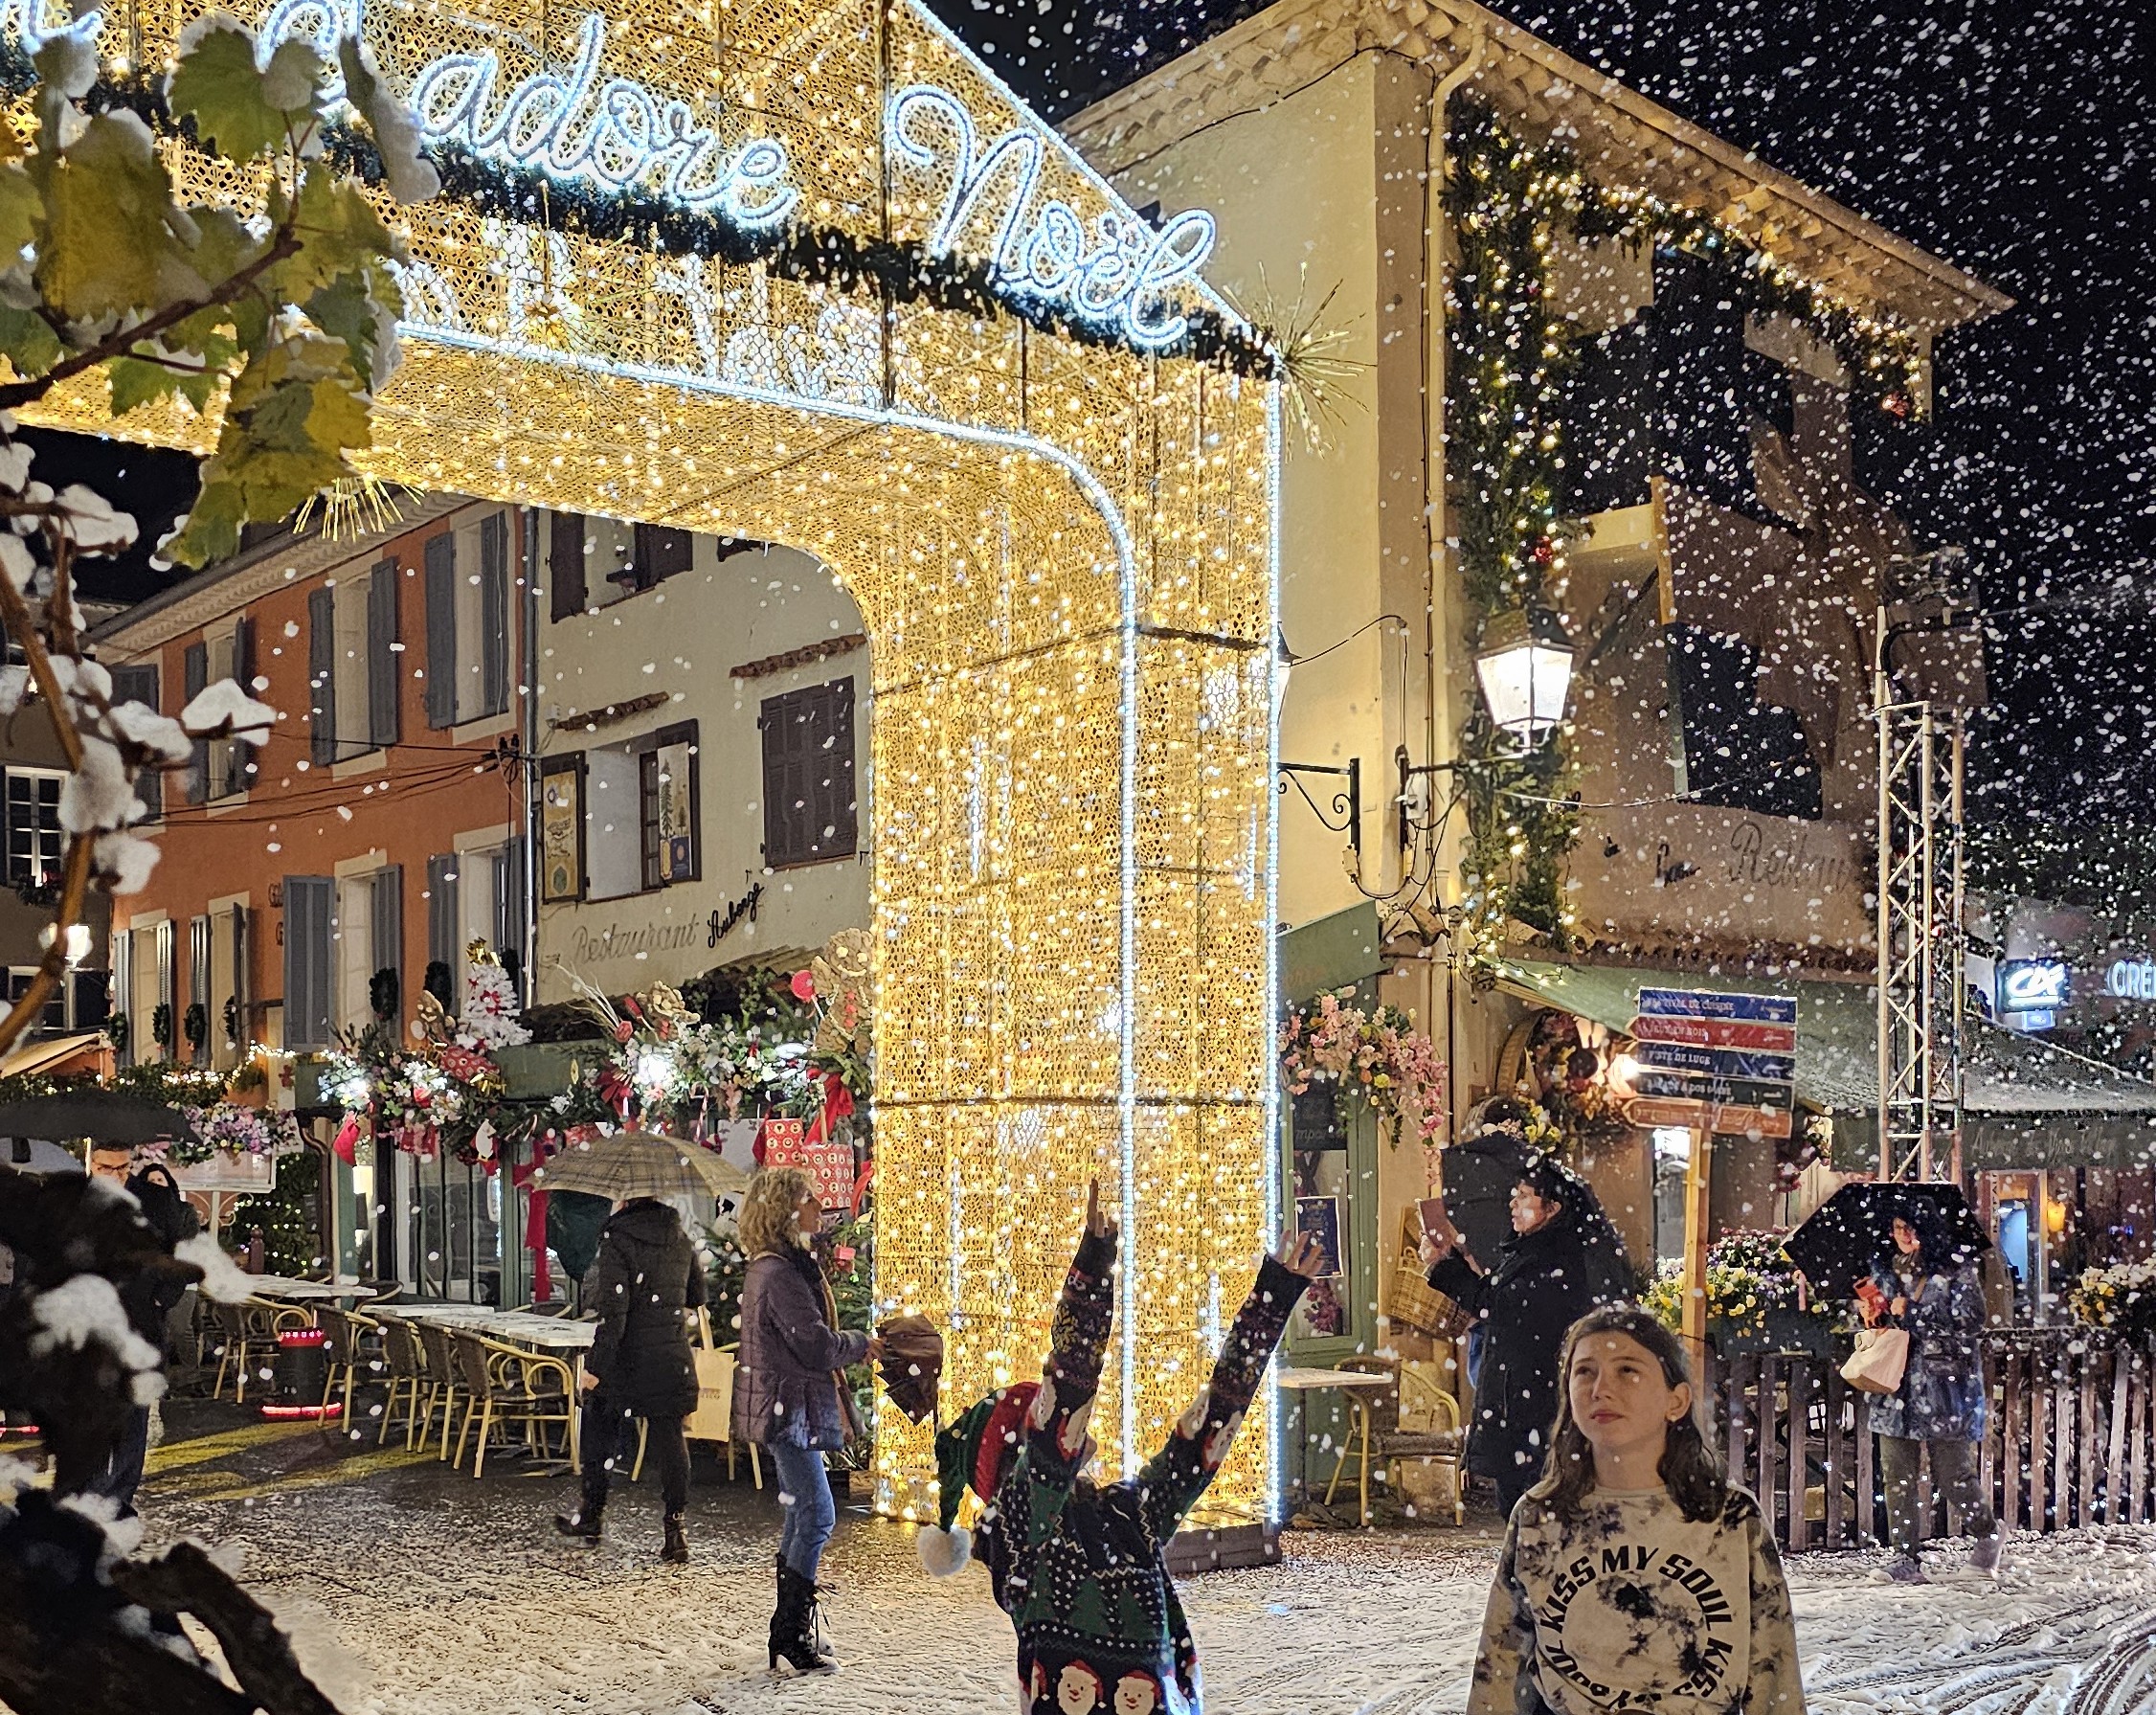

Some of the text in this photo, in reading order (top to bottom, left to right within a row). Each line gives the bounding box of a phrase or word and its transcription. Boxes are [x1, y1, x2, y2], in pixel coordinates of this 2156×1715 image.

[414, 13, 797, 229] adore
[887, 83, 1216, 348] Noël
[572, 913, 700, 965] Restaurant
[707, 881, 765, 949] Auberge
[1674, 1053, 1687, 1062] DE
[1601, 1545, 1660, 1573] MY
[1539, 1555, 1597, 1634] KISS
[1658, 1553, 1733, 1632] SOUL
[1672, 1636, 1734, 1698] KISS
